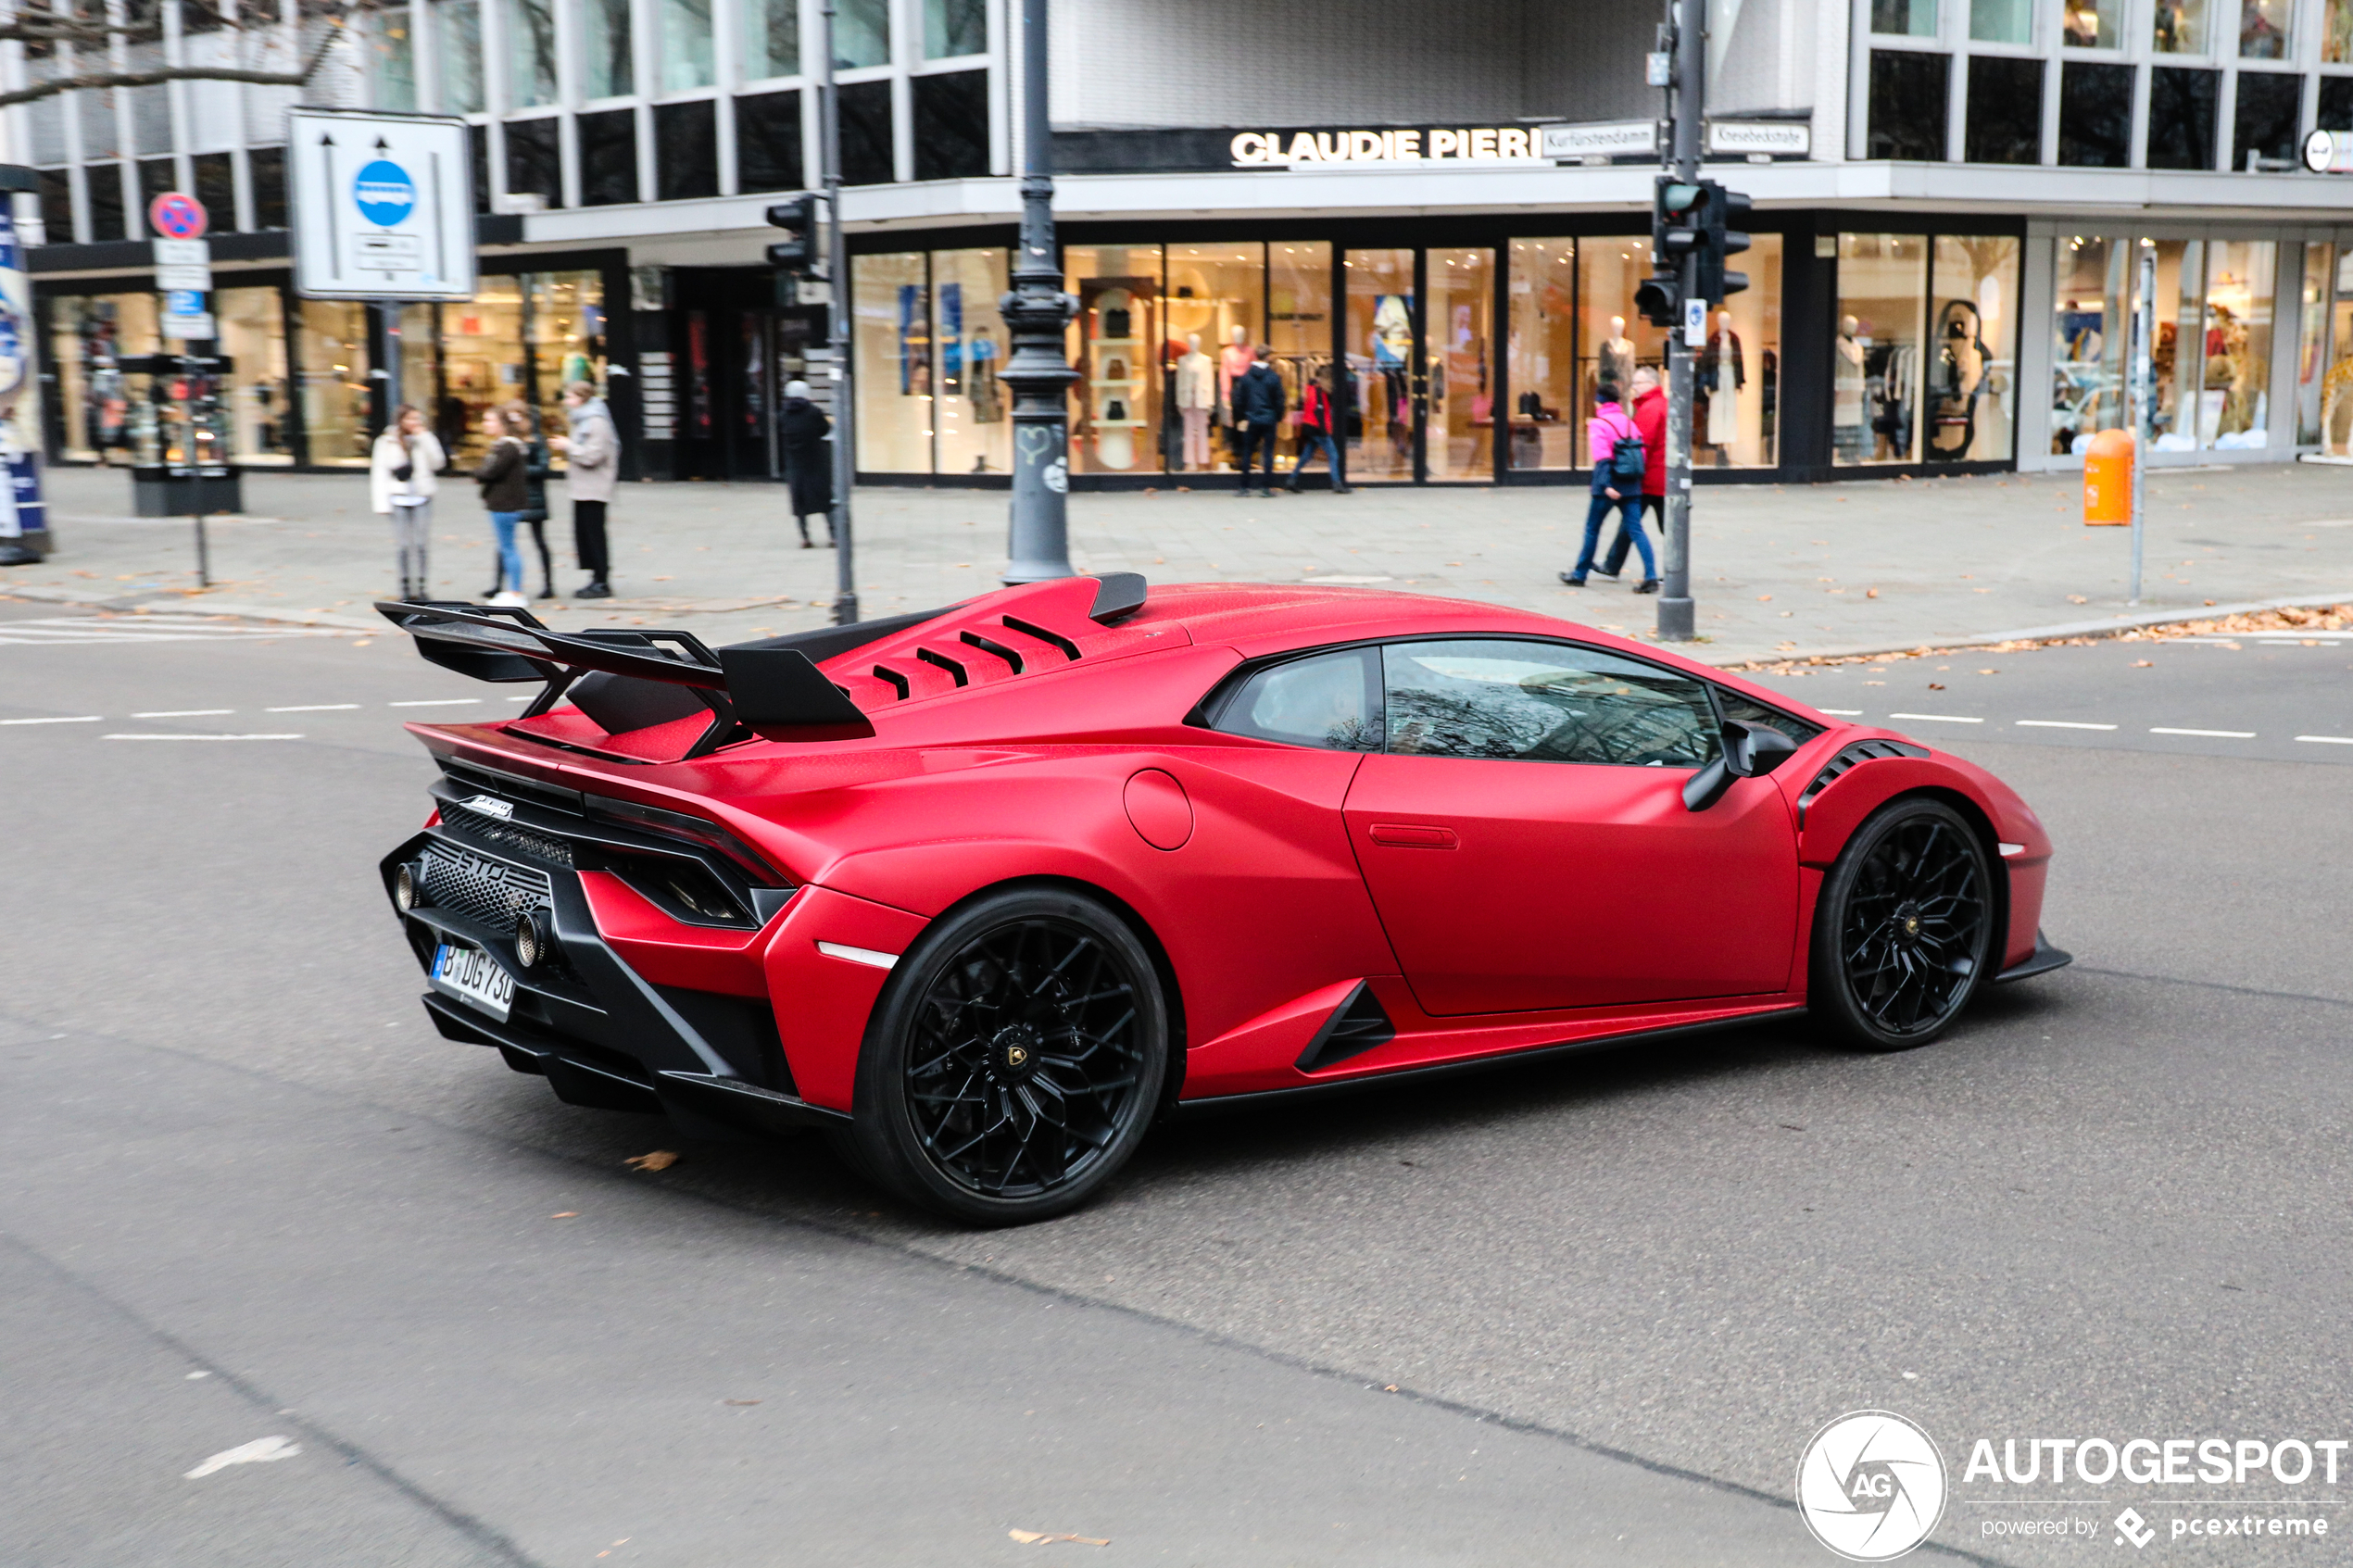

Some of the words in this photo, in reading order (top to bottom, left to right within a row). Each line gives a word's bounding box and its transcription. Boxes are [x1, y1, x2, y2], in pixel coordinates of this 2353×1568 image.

[1230, 130, 1421, 163] CLAUDIE
[1547, 132, 1649, 148] Kurfürstendamm
[460, 852, 506, 881] STO
[443, 946, 456, 976] B
